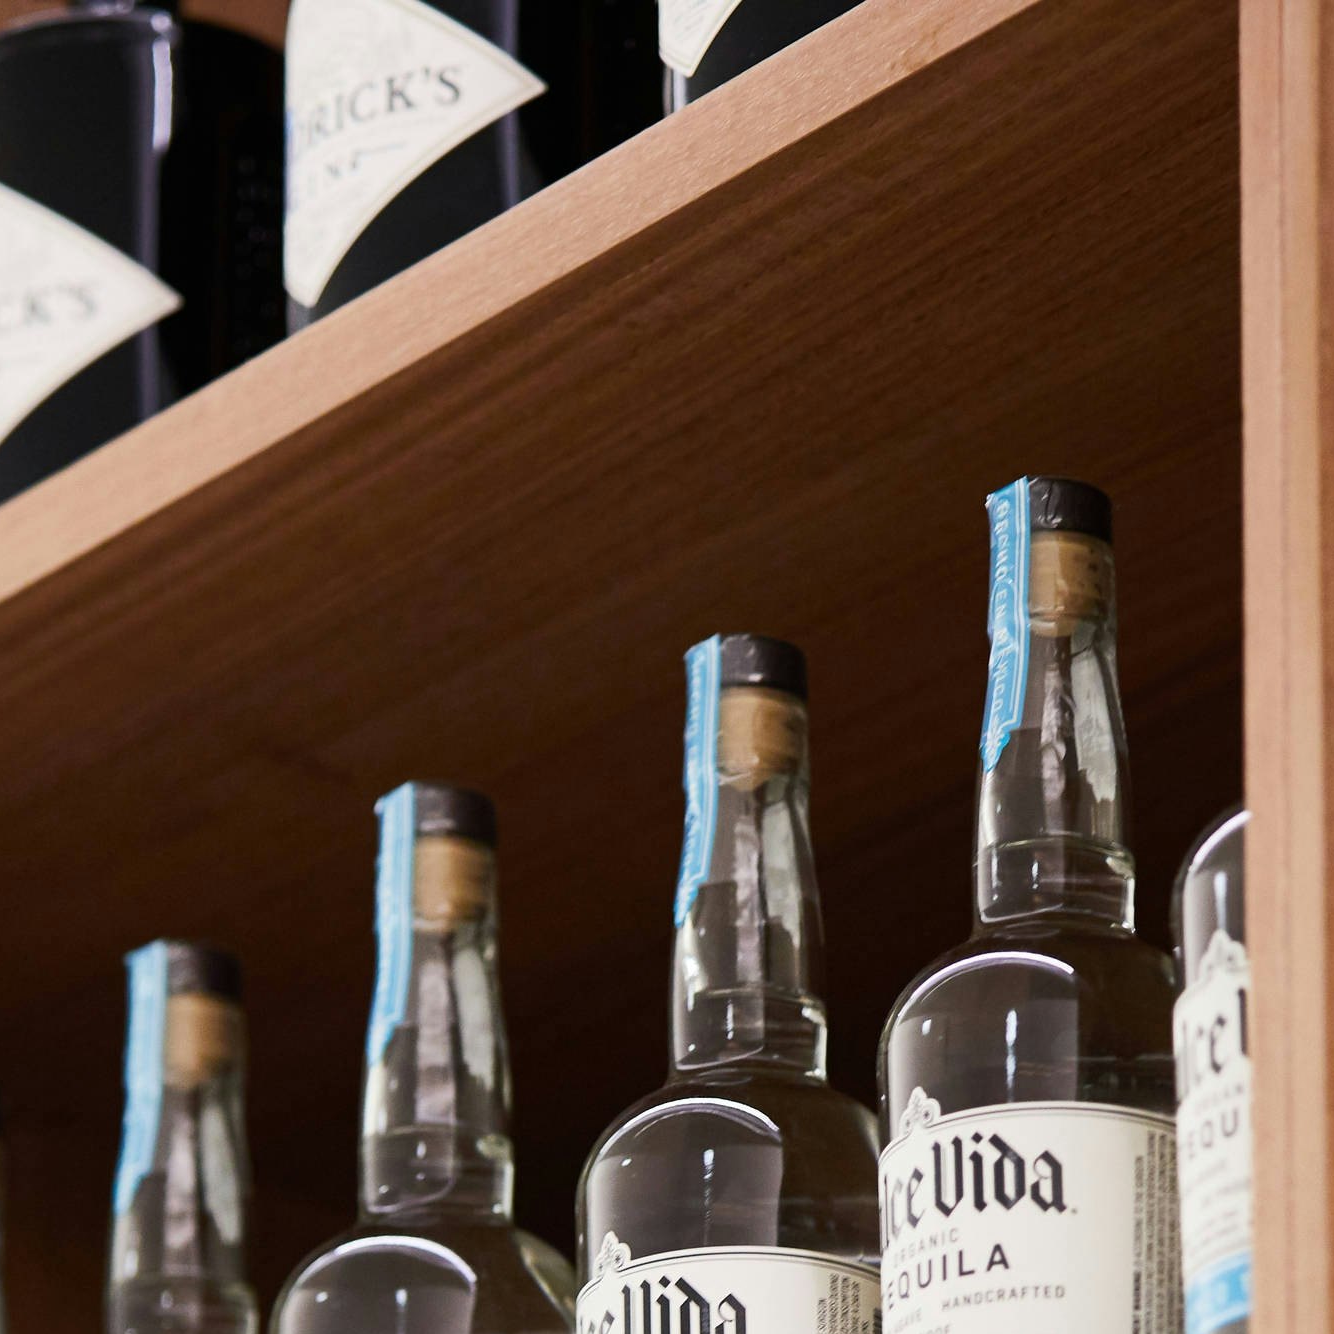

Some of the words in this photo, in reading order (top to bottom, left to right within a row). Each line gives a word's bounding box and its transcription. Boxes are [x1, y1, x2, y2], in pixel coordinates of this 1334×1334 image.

[303, 64, 466, 146] RICK'S
[932, 1131, 1067, 1218] Vida
[888, 1243, 1010, 1310] EQUILA
[942, 1285, 1066, 1312] HANDCRAFTED
